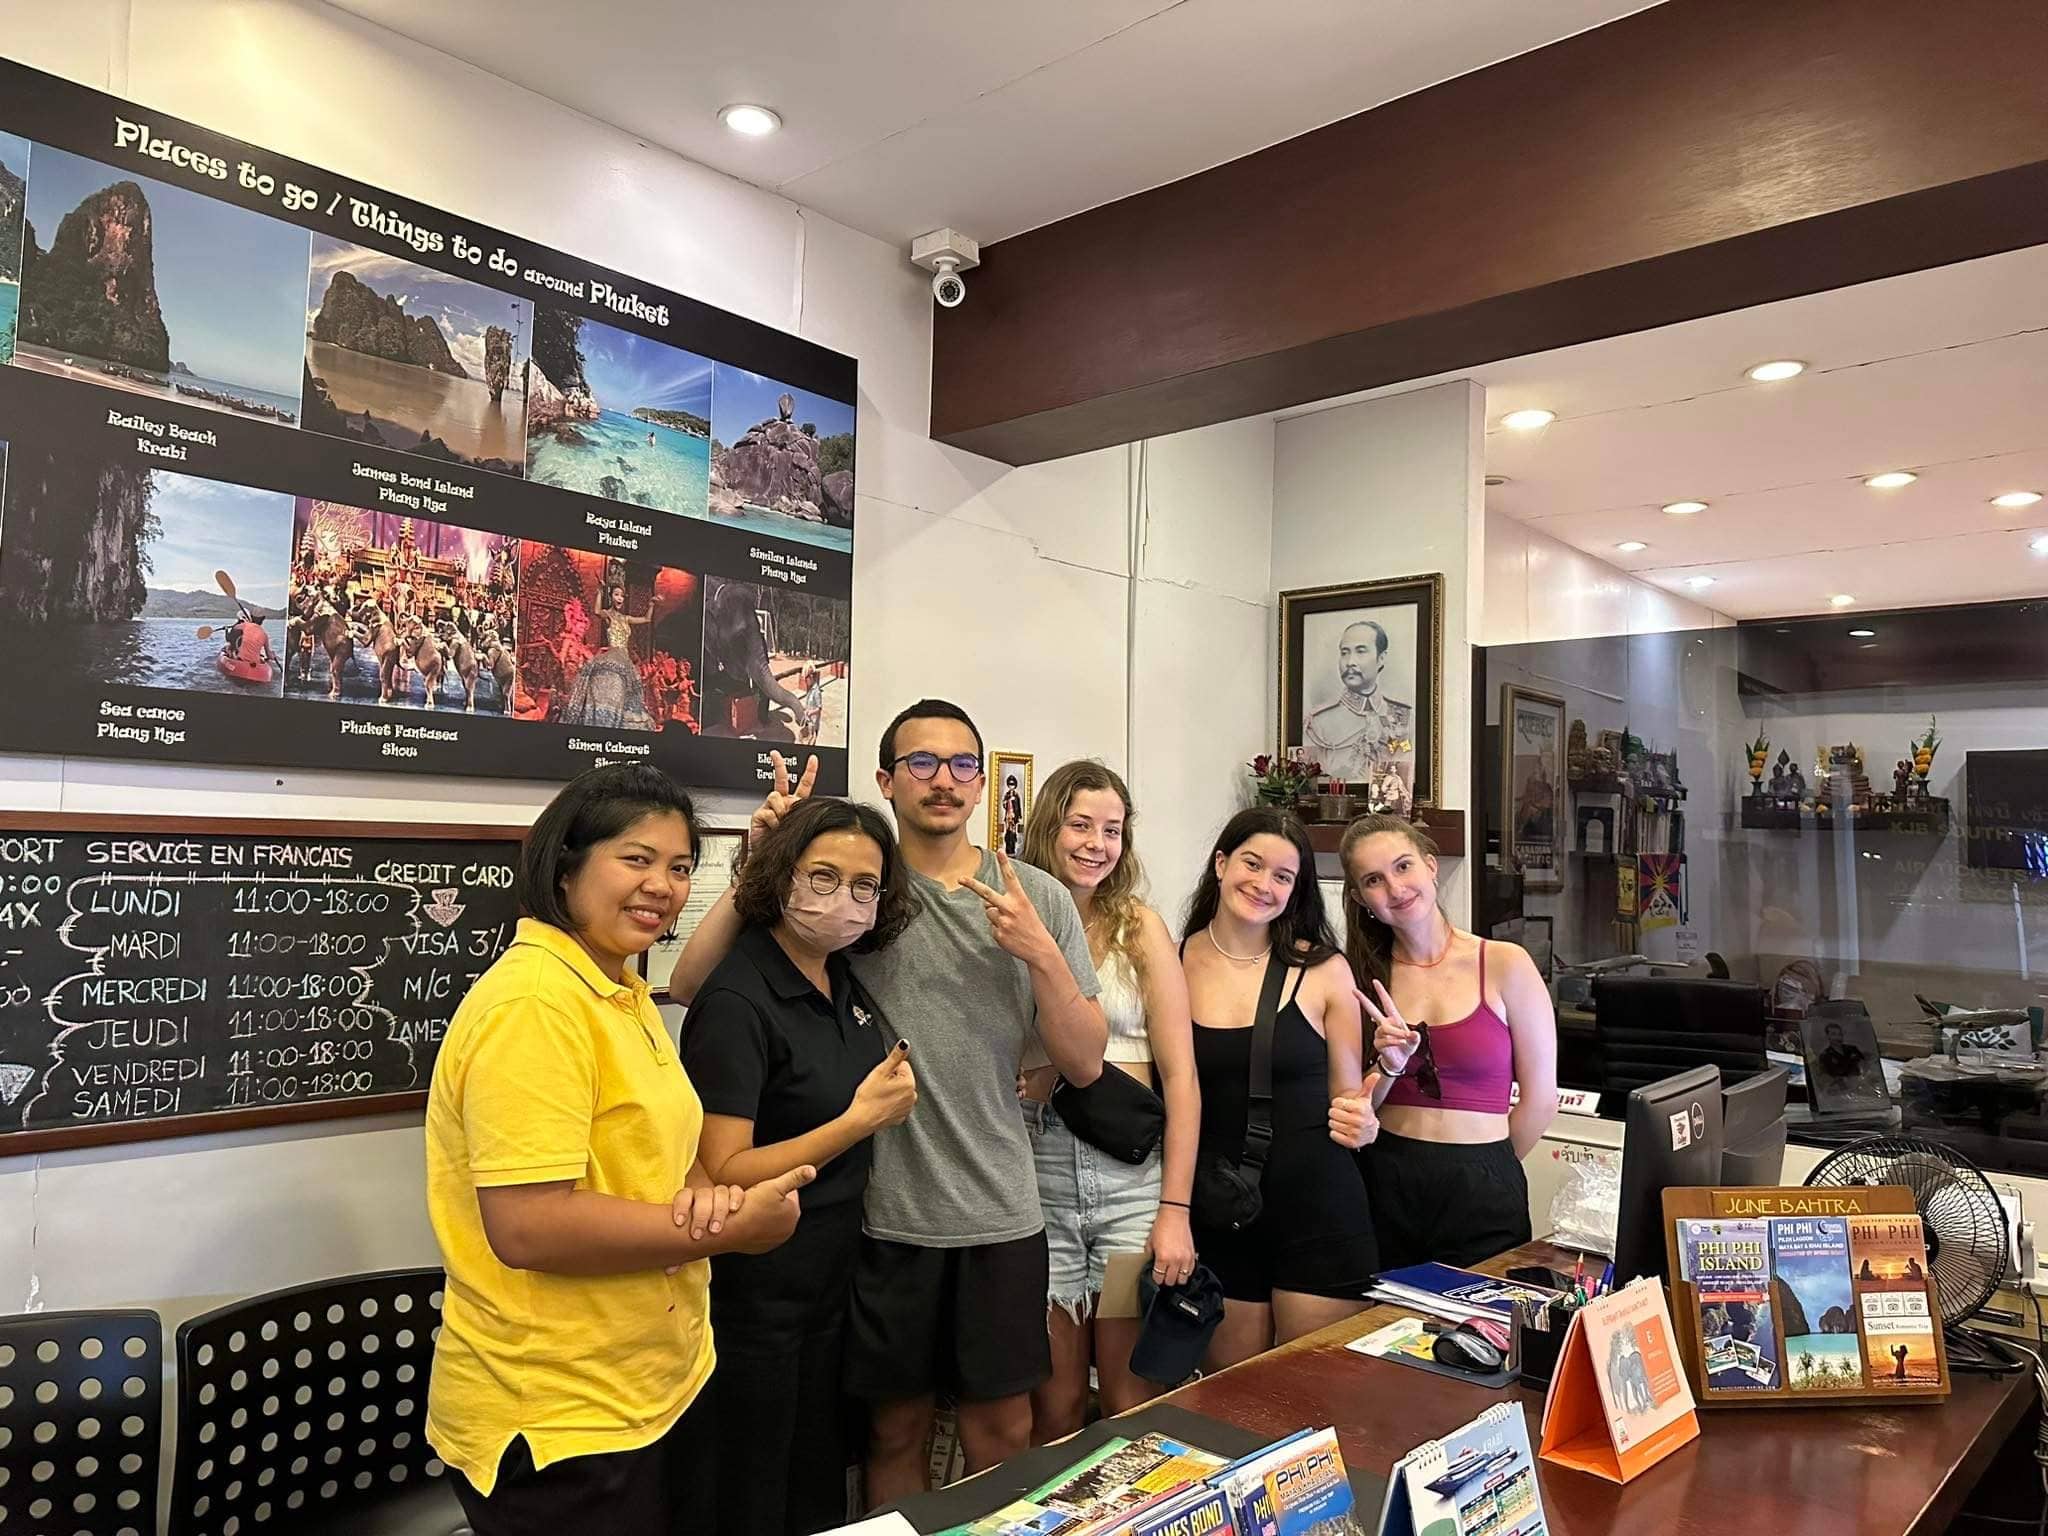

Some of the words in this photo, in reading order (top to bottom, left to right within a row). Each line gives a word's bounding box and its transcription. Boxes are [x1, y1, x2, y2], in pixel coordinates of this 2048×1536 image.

[114, 116, 229, 180] Places
[237, 160, 275, 196] to
[281, 182, 319, 211] go
[350, 197, 444, 253] Things
[451, 233, 482, 265] to
[488, 248, 518, 277] do
[523, 268, 584, 299] around
[589, 279, 670, 327] Phuket
[107, 409, 165, 437] Railey
[168, 423, 217, 447] Beach
[136, 437, 188, 461] Krabi
[352, 462, 398, 484] James
[400, 471, 432, 491] Bond
[434, 478, 475, 499] Island
[378, 487, 420, 510] Phang
[422, 495, 448, 514] Nga
[585, 511, 617, 532] Raya
[618, 517, 652, 537] Island
[598, 531, 639, 551] Phuket
[749, 547, 785, 567] Similan
[786, 554, 818, 572] Islands
[760, 564, 789, 583] Phang
[790, 569, 808, 585] Nga
[100, 700, 133, 718] Sea
[136, 705, 186, 721] canoe
[96, 722, 151, 744] Phang
[153, 726, 186, 745] Nga
[340, 719, 392, 737] Phuket
[394, 724, 459, 742] Fantasea
[381, 742, 419, 758] Show
[567, 738, 603, 753] Simon
[604, 740, 650, 756] Cabaret
[86, 838, 204, 865] SERVICE
[210, 844, 244, 866] EN
[253, 842, 353, 868] FRANCAIS
[374, 858, 457, 885] CREDIT
[461, 862, 514, 889] CARD
[90, 888, 181, 917] LUNDI
[232, 887, 390, 915] 11:00-18:00
[110, 930, 181, 960] MARDI
[226, 930, 367, 957] 11:00-18:00
[401, 929, 460, 955] VISA
[82, 977, 207, 1007] MERCREDI
[226, 973, 363, 999] 11:00-18:00
[403, 967, 451, 1002] M/C
[87, 1015, 188, 1050] JEUDI
[228, 1005, 374, 1040] 11:00-18:00
[71, 1055, 206, 1087] VENDREDI
[226, 1039, 374, 1077] 11:00-18:00
[71, 1087, 181, 1118] SAMEDI
[226, 1070, 374, 1105] 11:00-18:00
[1725, 1197, 1775, 1214] JUNE
[1779, 1198, 1861, 1214] BAHTRA
[1777, 1223, 1794, 1235] PHI
[1796, 1222, 1813, 1235] PHI
[1852, 1225, 1879, 1240] PHI
[1888, 1224, 1920, 1240] PHI
[1698, 1241, 1728, 1256] PHI
[1732, 1241, 1761, 1256] PHI
[1700, 1256, 1763, 1272] ISLAND
[1867, 1321, 1896, 1331] Sunset
[1275, 1461, 1306, 1491] PHI
[1306, 1448, 1335, 1476] PHI
[1190, 1499, 1224, 1536] BOND
[1253, 1494, 1272, 1525] PHI
